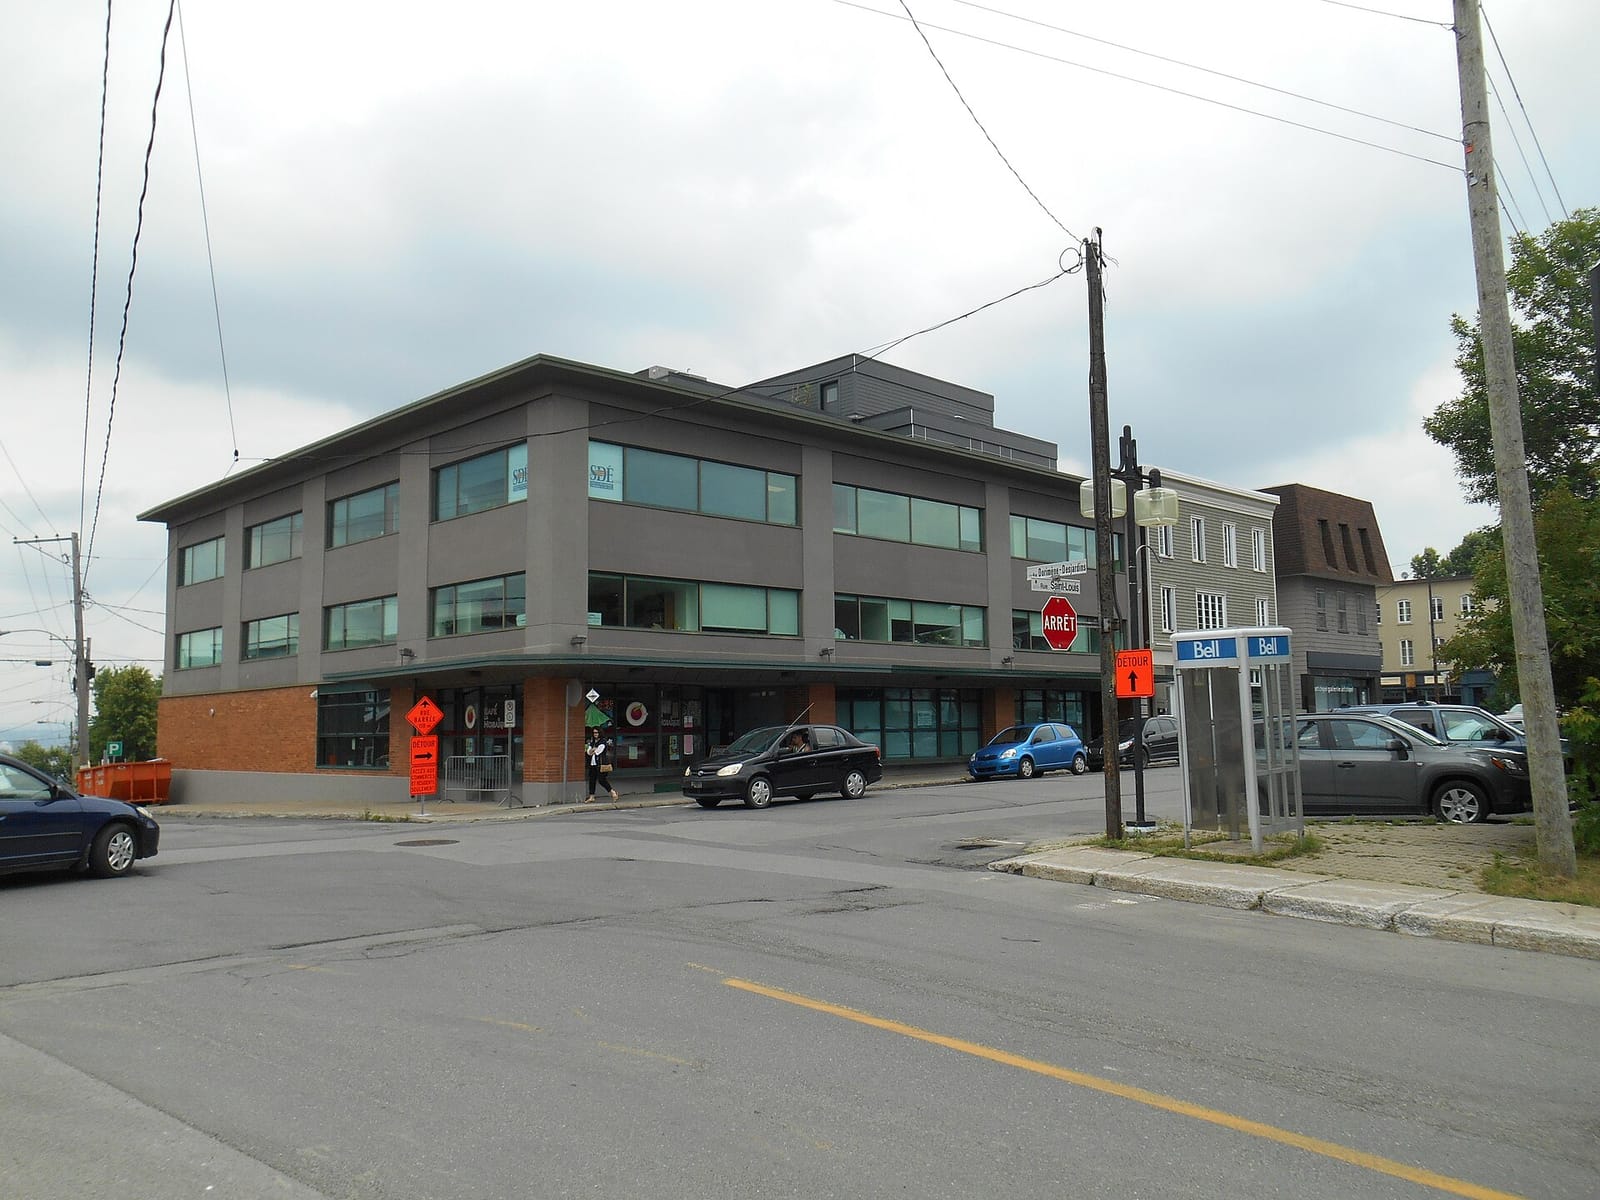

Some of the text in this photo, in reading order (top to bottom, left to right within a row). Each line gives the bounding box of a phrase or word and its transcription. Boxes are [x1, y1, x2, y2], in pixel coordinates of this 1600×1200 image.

[1051, 580, 1079, 592] Saint-Louis
[1044, 614, 1075, 631] ARRÊT
[1193, 640, 1219, 658] Bell
[1259, 637, 1278, 655] Bell
[1117, 656, 1149, 667] DÉTOUR
[109, 744, 119, 754] P
